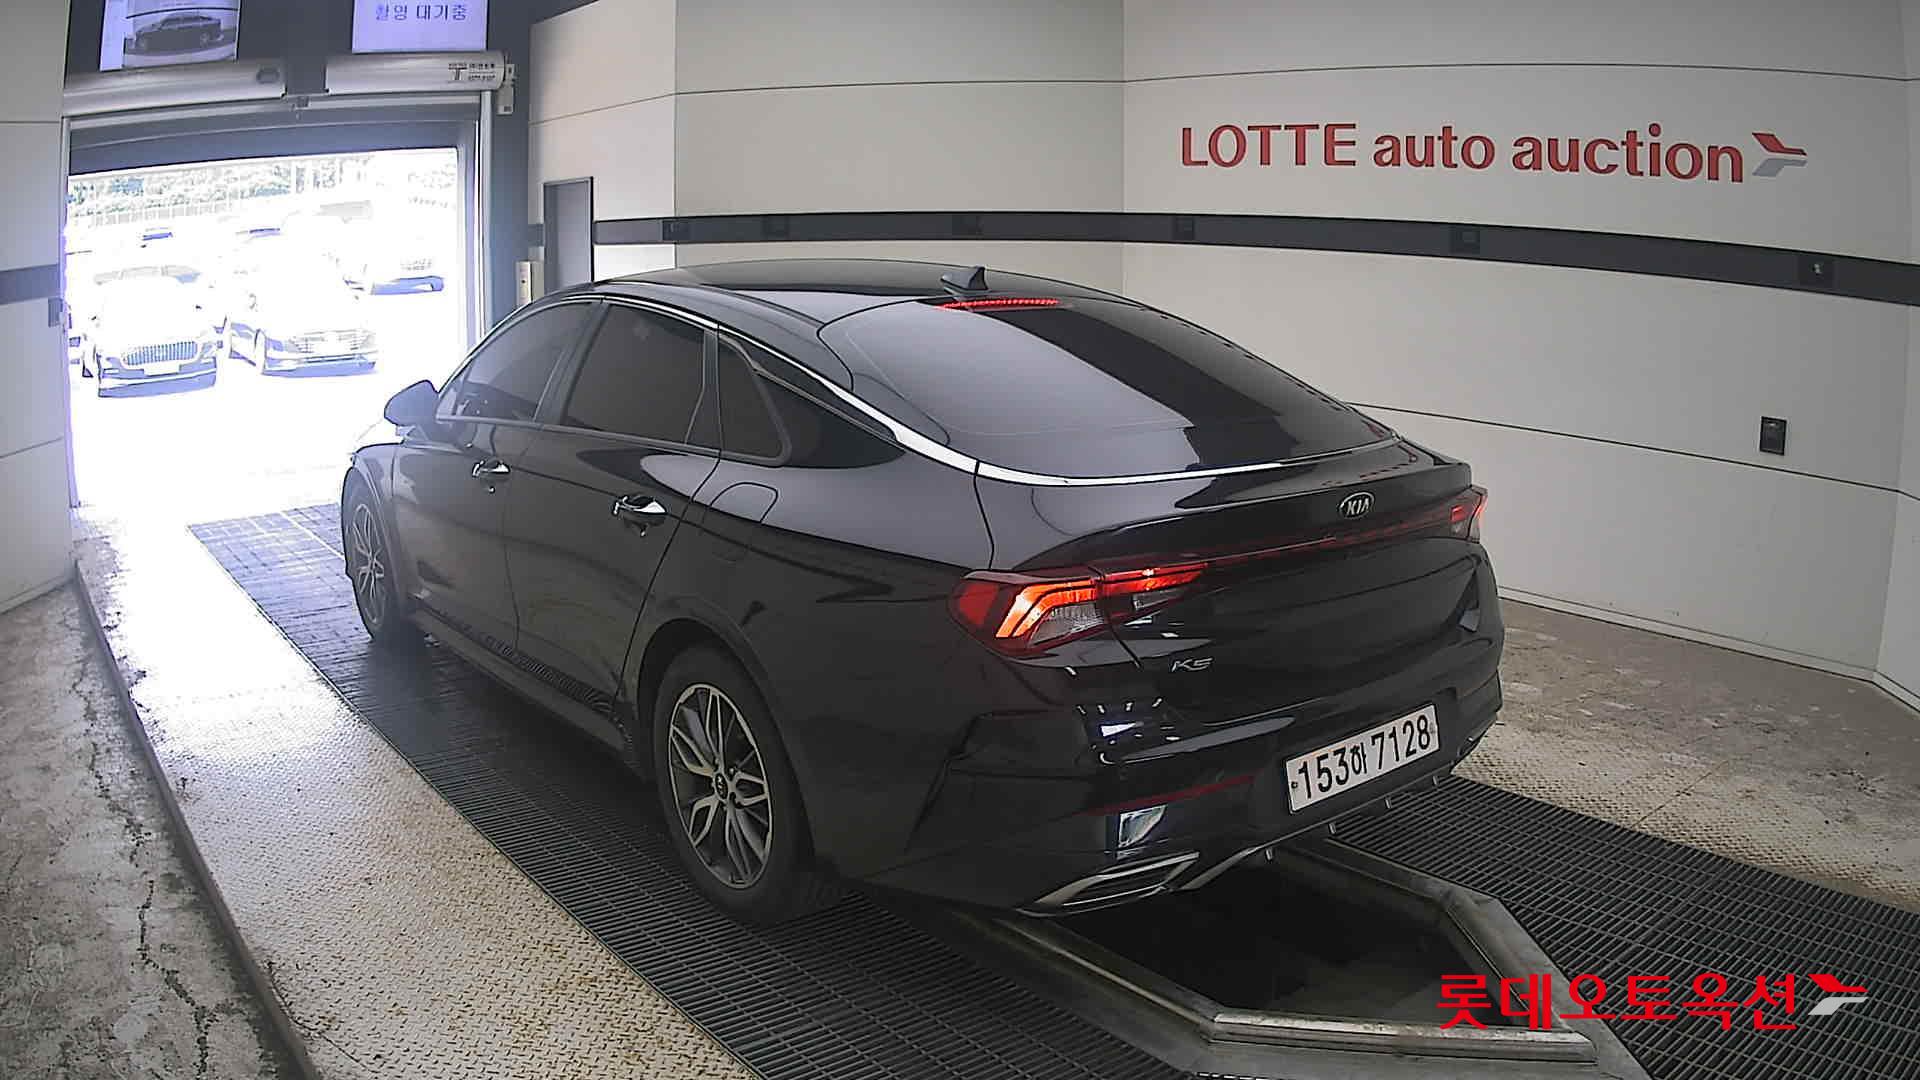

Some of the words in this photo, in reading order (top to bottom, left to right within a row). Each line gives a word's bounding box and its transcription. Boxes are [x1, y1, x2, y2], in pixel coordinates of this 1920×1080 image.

[416, 4, 468, 21] 대기중
[1181, 123, 1357, 168] LOTTE
[1373, 126, 1496, 169] auto
[1512, 123, 1744, 183] auction
[1346, 497, 1370, 516] KIA
[1171, 657, 1213, 673] K5
[1298, 742, 1368, 799] 153하
[1371, 714, 1431, 770] 7128
